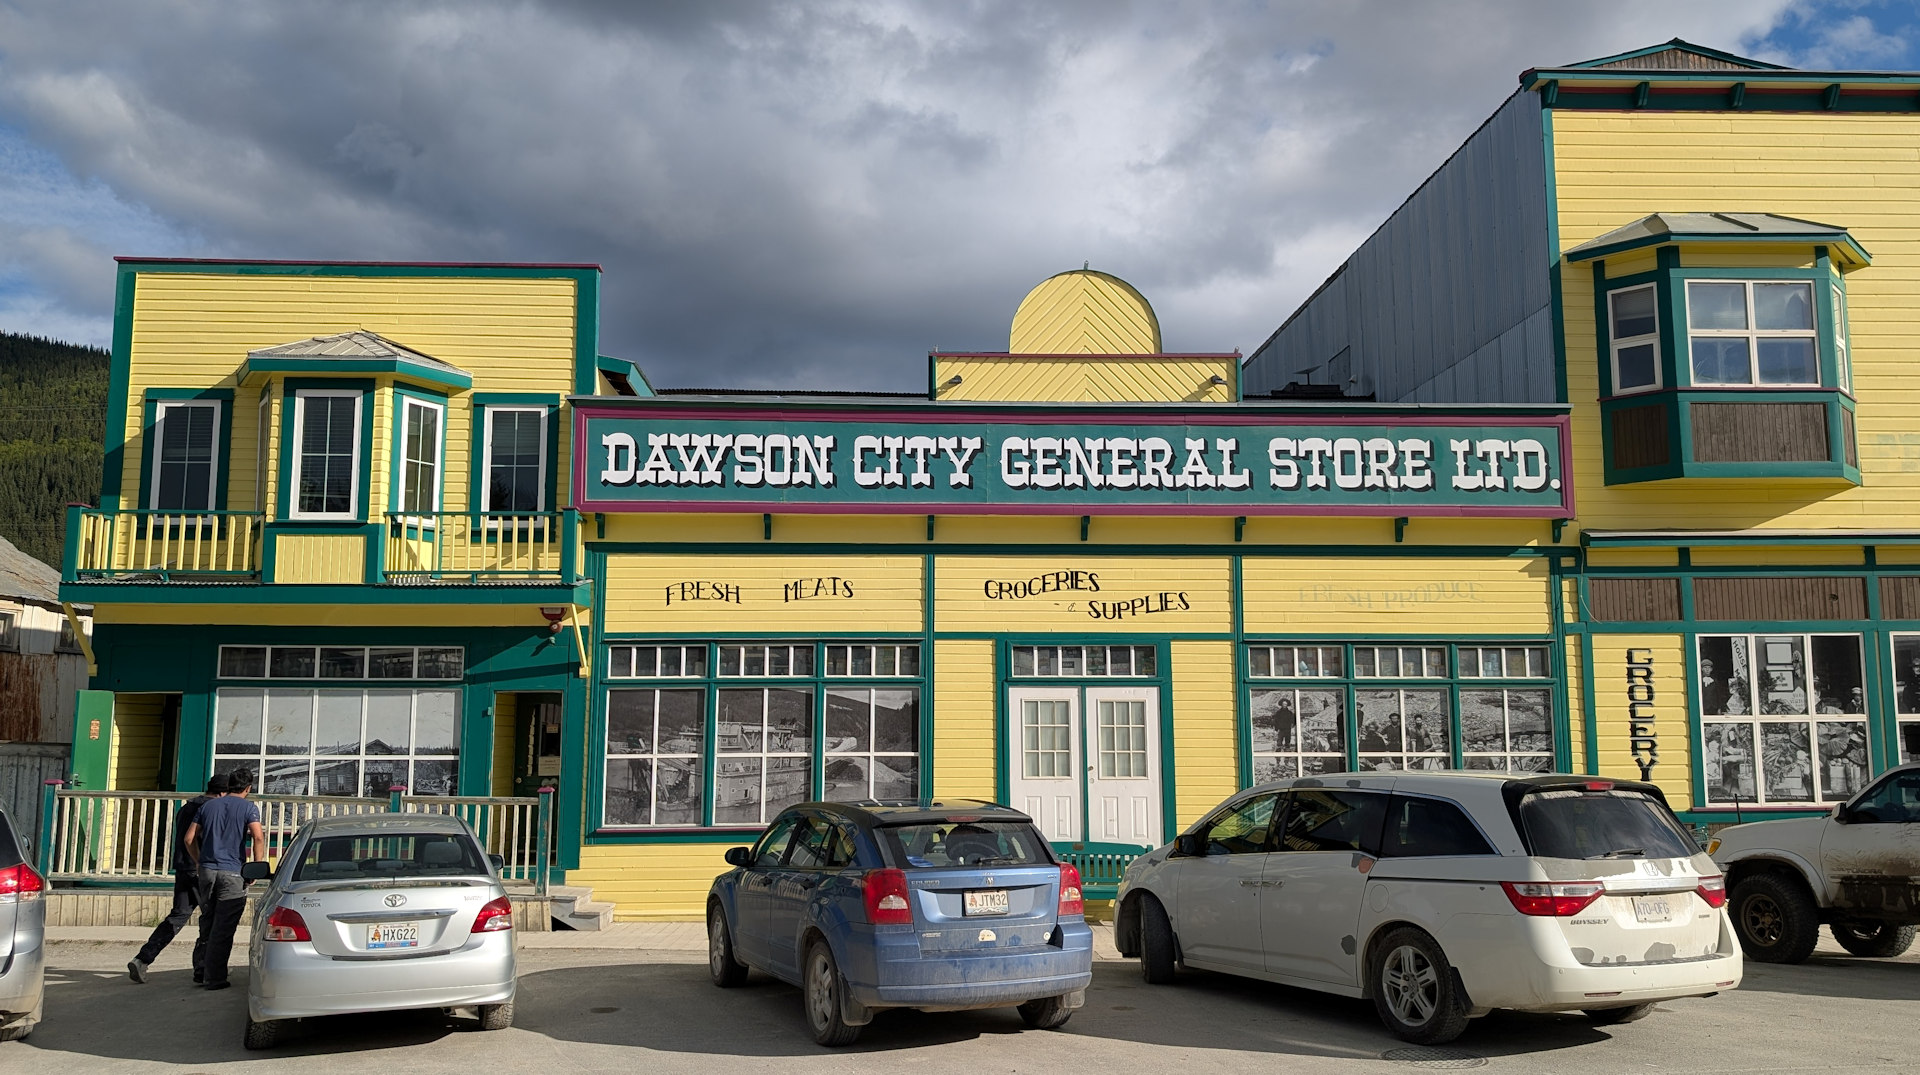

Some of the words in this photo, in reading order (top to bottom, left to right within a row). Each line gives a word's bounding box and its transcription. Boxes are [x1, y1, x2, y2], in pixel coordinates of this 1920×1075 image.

[601, 432, 837, 488] DAWSON
[853, 435, 983, 488] CITY
[1000, 436, 1252, 490] GENERAL
[1267, 437, 1434, 491] STORE
[1450, 438, 1562, 491] LTD.
[665, 580, 742, 606] FRESH
[783, 576, 854, 603] MEATS
[984, 569, 1101, 600] GROCERIES
[1299, 583, 1374, 609] FRESH
[1382, 580, 1486, 609] PRODUCE
[1088, 591, 1190, 620] SUPPLIES
[1626, 648, 1660, 782] GROCERY
[978, 893, 1008, 907] JTM32
[382, 928, 417, 942] HXG22
